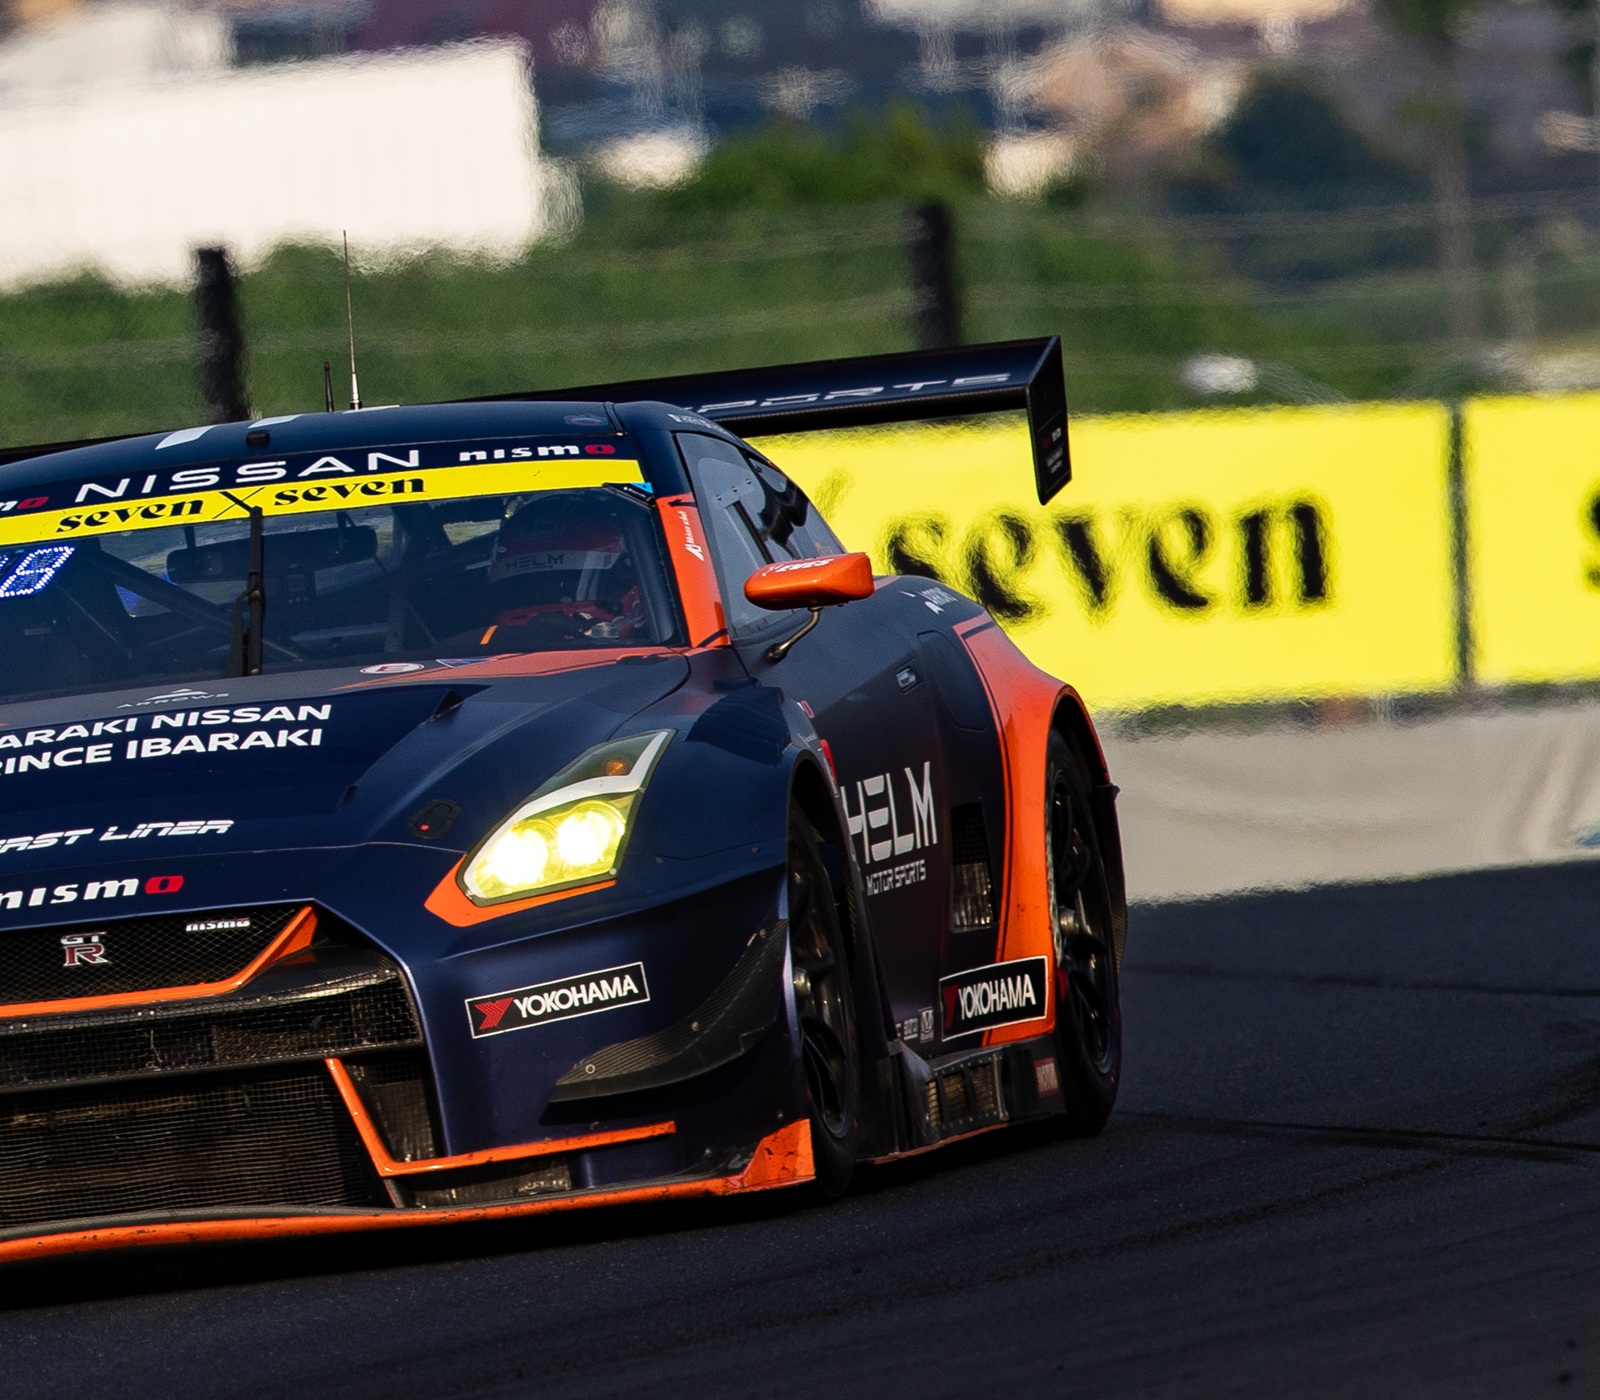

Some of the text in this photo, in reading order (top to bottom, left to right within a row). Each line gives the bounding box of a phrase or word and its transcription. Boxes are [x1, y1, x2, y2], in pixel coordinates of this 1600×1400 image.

[683, 373, 1011, 414] PORTS
[459, 444, 615, 462] nismo
[75, 450, 419, 503] NISSAN
[56, 500, 203, 533] seven
[274, 477, 427, 506] seven
[506, 554, 565, 572] HELM
[116, 693, 229, 709] ARROWS
[151, 704, 332, 729] NISSAN
[126, 728, 323, 759] IBARAKI
[840, 761, 938, 865] HELM
[99, 820, 235, 841] LINER
[866, 859, 927, 896] MOTOR SPORTS
[60, 931, 107, 945] GT
[186, 918, 250, 932] nismo
[62, 943, 113, 967] R
[514, 975, 639, 1018] YOKOHAMA
[958, 973, 1037, 1020] YOKOHAMA
